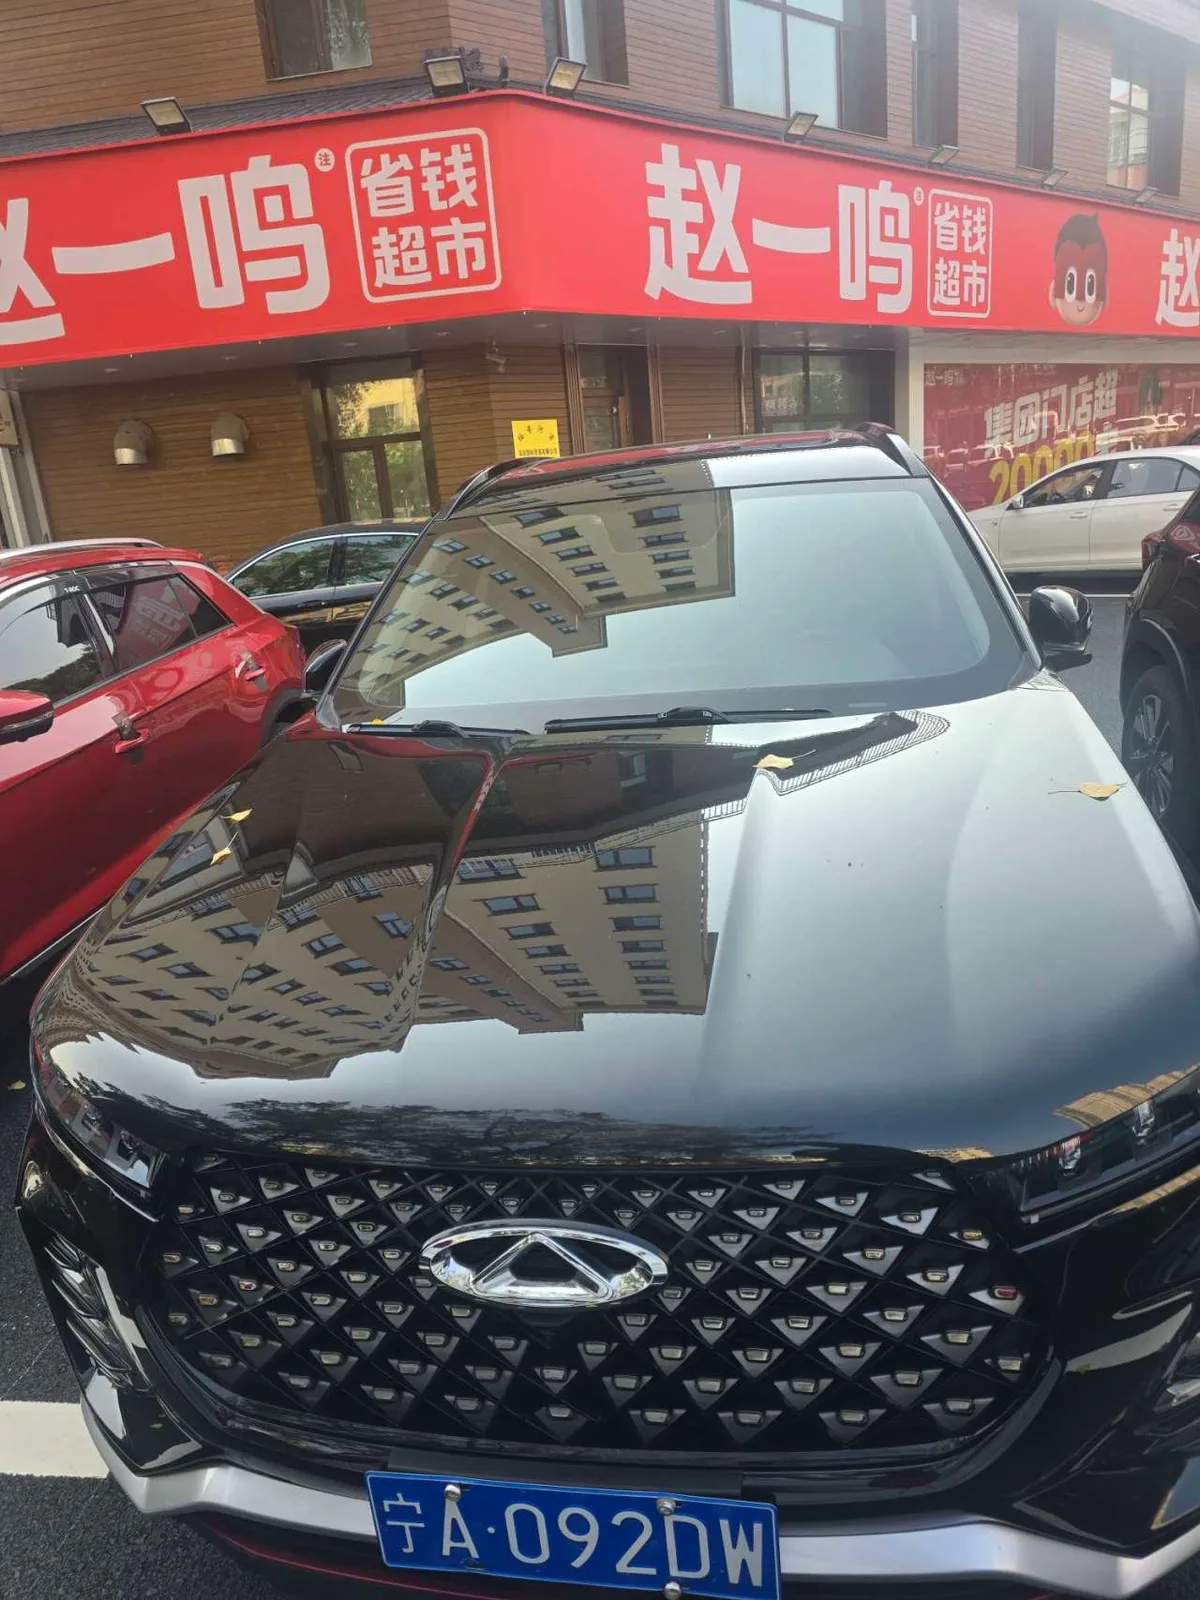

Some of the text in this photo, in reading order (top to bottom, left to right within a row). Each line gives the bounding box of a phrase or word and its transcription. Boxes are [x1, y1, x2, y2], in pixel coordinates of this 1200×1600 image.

[360, 143, 478, 218] 省钱
[371, 217, 486, 288] 超市
[644, 143, 913, 313] 赵一鸣
[934, 201, 986, 255] 省钱
[933, 257, 988, 307] 超市
